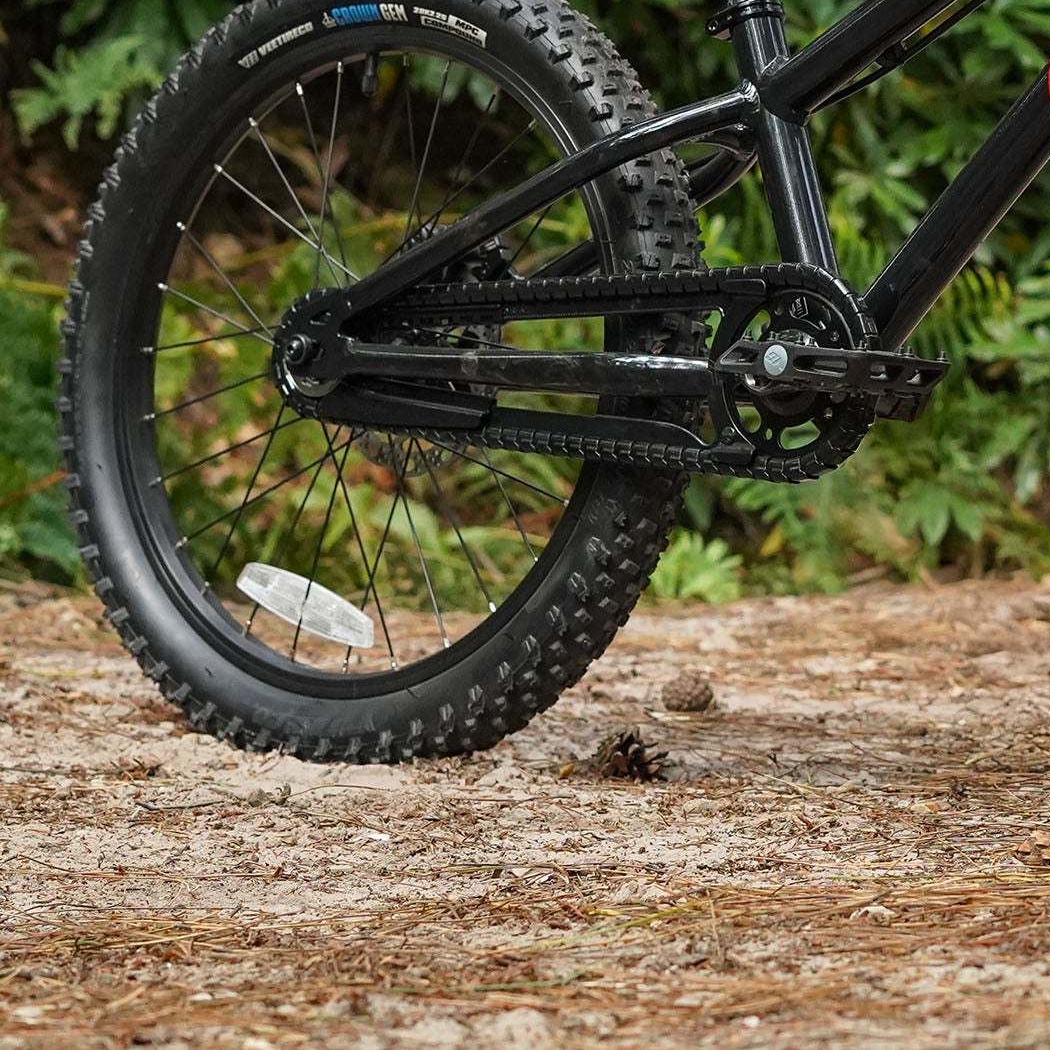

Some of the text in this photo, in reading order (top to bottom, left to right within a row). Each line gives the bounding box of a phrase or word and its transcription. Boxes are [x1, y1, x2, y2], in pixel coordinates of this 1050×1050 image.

[331, 3, 382, 26] CROWN
[379, 3, 409, 22] GEM
[455, 19, 480, 36] MPC
[423, 17, 483, 46] COMPOUND
